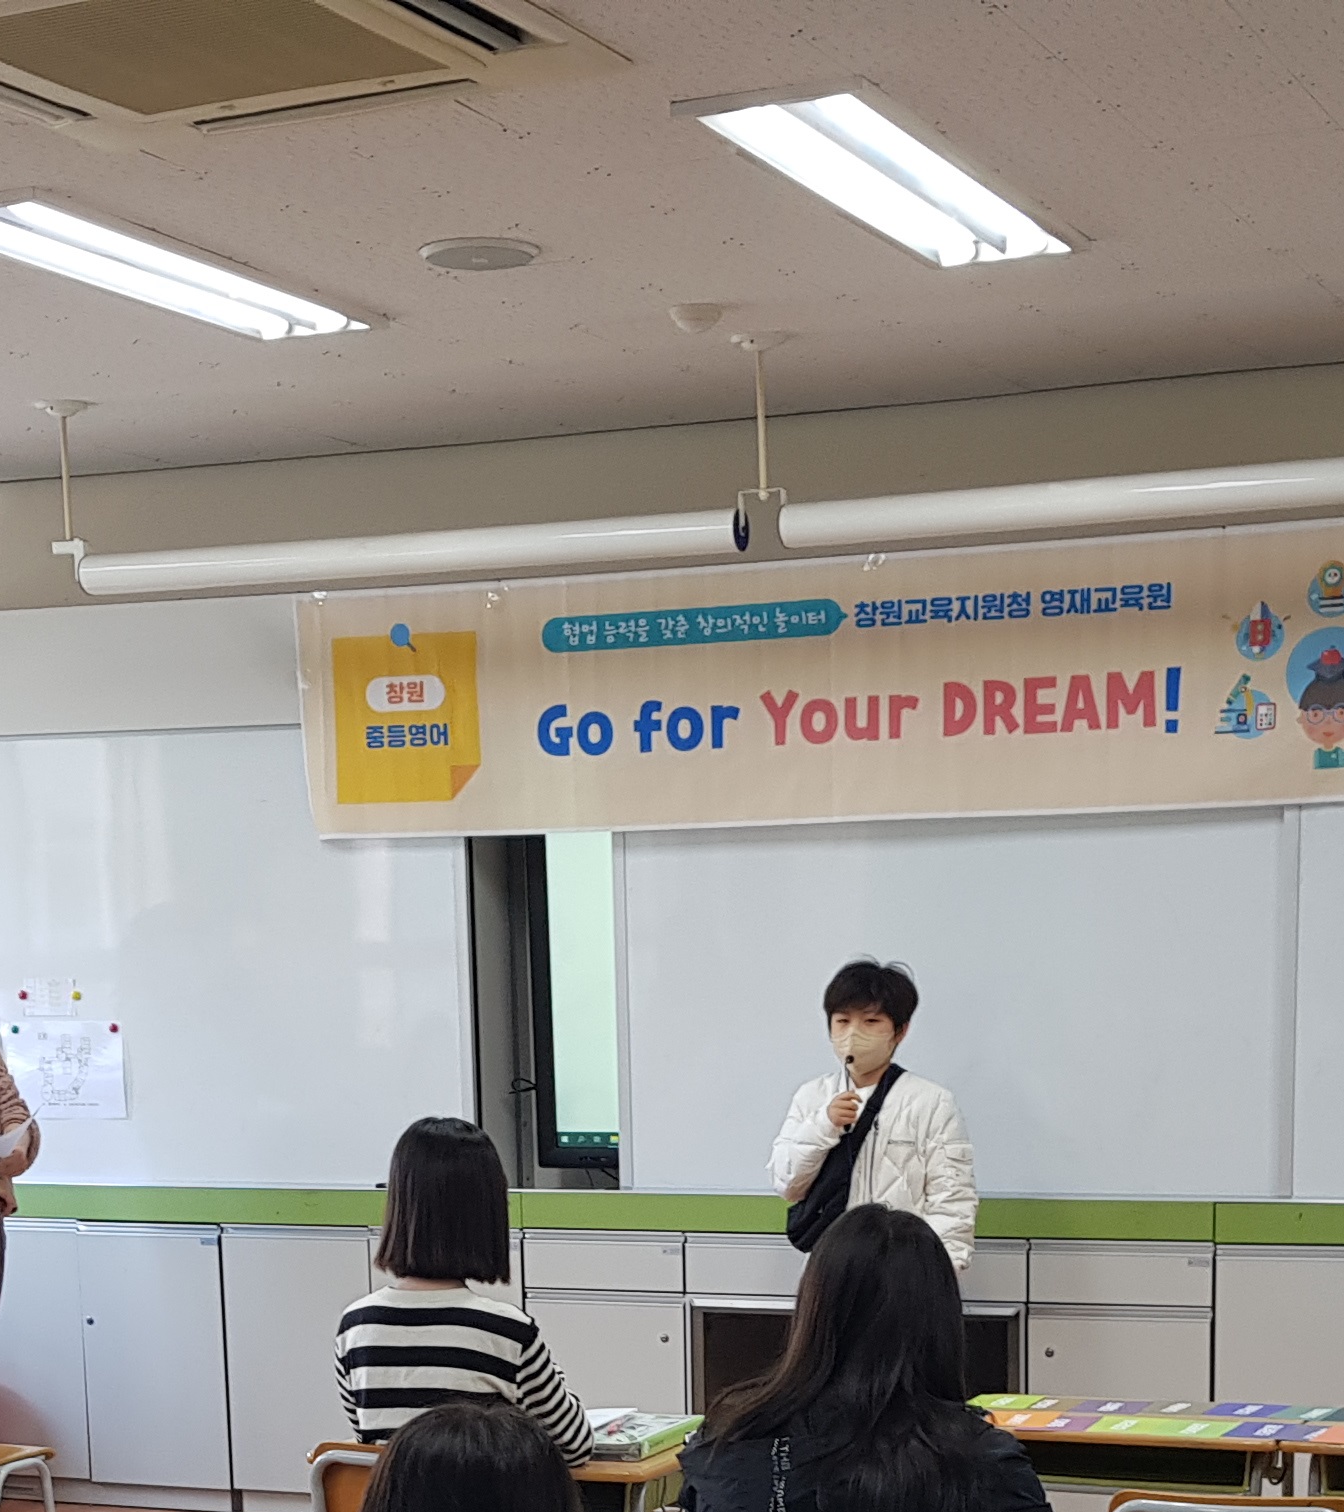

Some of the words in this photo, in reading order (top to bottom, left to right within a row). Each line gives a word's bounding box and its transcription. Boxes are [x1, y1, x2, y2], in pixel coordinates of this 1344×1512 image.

[853, 590, 1032, 629] 창원교육지원청
[1039, 581, 1173, 618] 영재교육원
[561, 620, 598, 647] 협업
[603, 616, 650, 643] 능력을
[656, 614, 690, 640] 갖춘
[697, 610, 769, 636] 창의적인
[773, 607, 827, 635] 놀이터
[385, 680, 425, 705] 창원
[536, 703, 614, 757] Go
[633, 700, 741, 753] for
[759, 688, 920, 747] Your
[941, 665, 1183, 738] DREAM!
[365, 722, 449, 749] 중등영어
